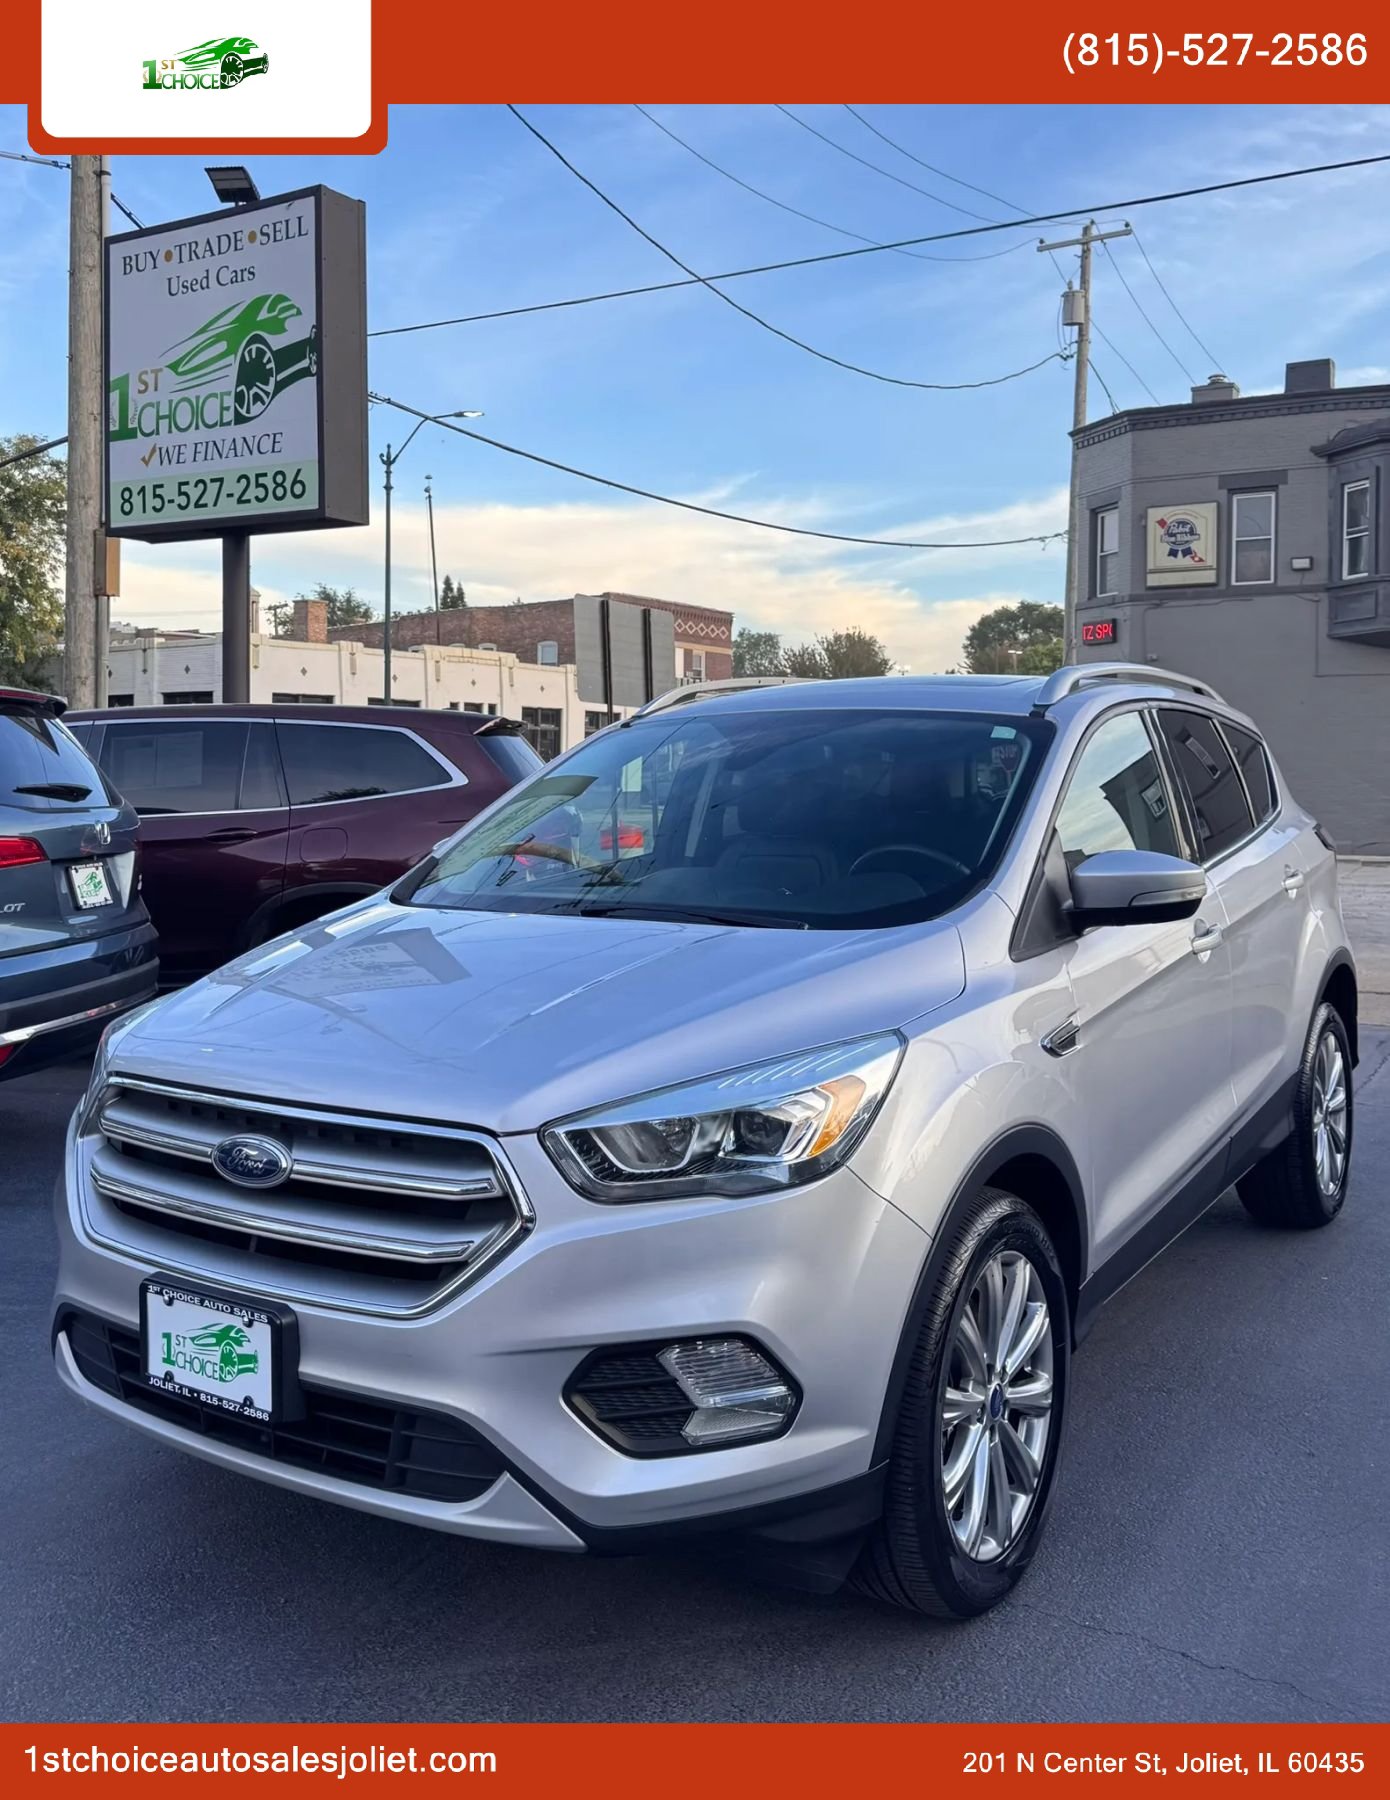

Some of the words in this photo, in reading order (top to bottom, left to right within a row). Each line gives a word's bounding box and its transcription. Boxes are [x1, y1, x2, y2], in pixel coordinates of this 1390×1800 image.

[121, 249, 160, 276] BUY
[174, 230, 244, 264] TRADE
[259, 216, 309, 246] SELL
[166, 269, 210, 297] Used
[216, 265, 256, 287] Cars
[137, 390, 233, 438] CHOICE
[158, 443, 187, 467] WE
[192, 432, 284, 463] FINANCE
[119, 468, 307, 517] 815-527-2586
[147, 1285, 160, 1293] 1ST
[163, 1288, 200, 1306] CHOICE
[203, 1299, 231, 1313] AUTO
[233, 1307, 268, 1323] SALES
[175, 1351, 219, 1381] CHOICE
[149, 1377, 181, 1394] JOLIET,
[182, 1387, 192, 1398] IL
[200, 1393, 270, 1422] 815-527-2586
